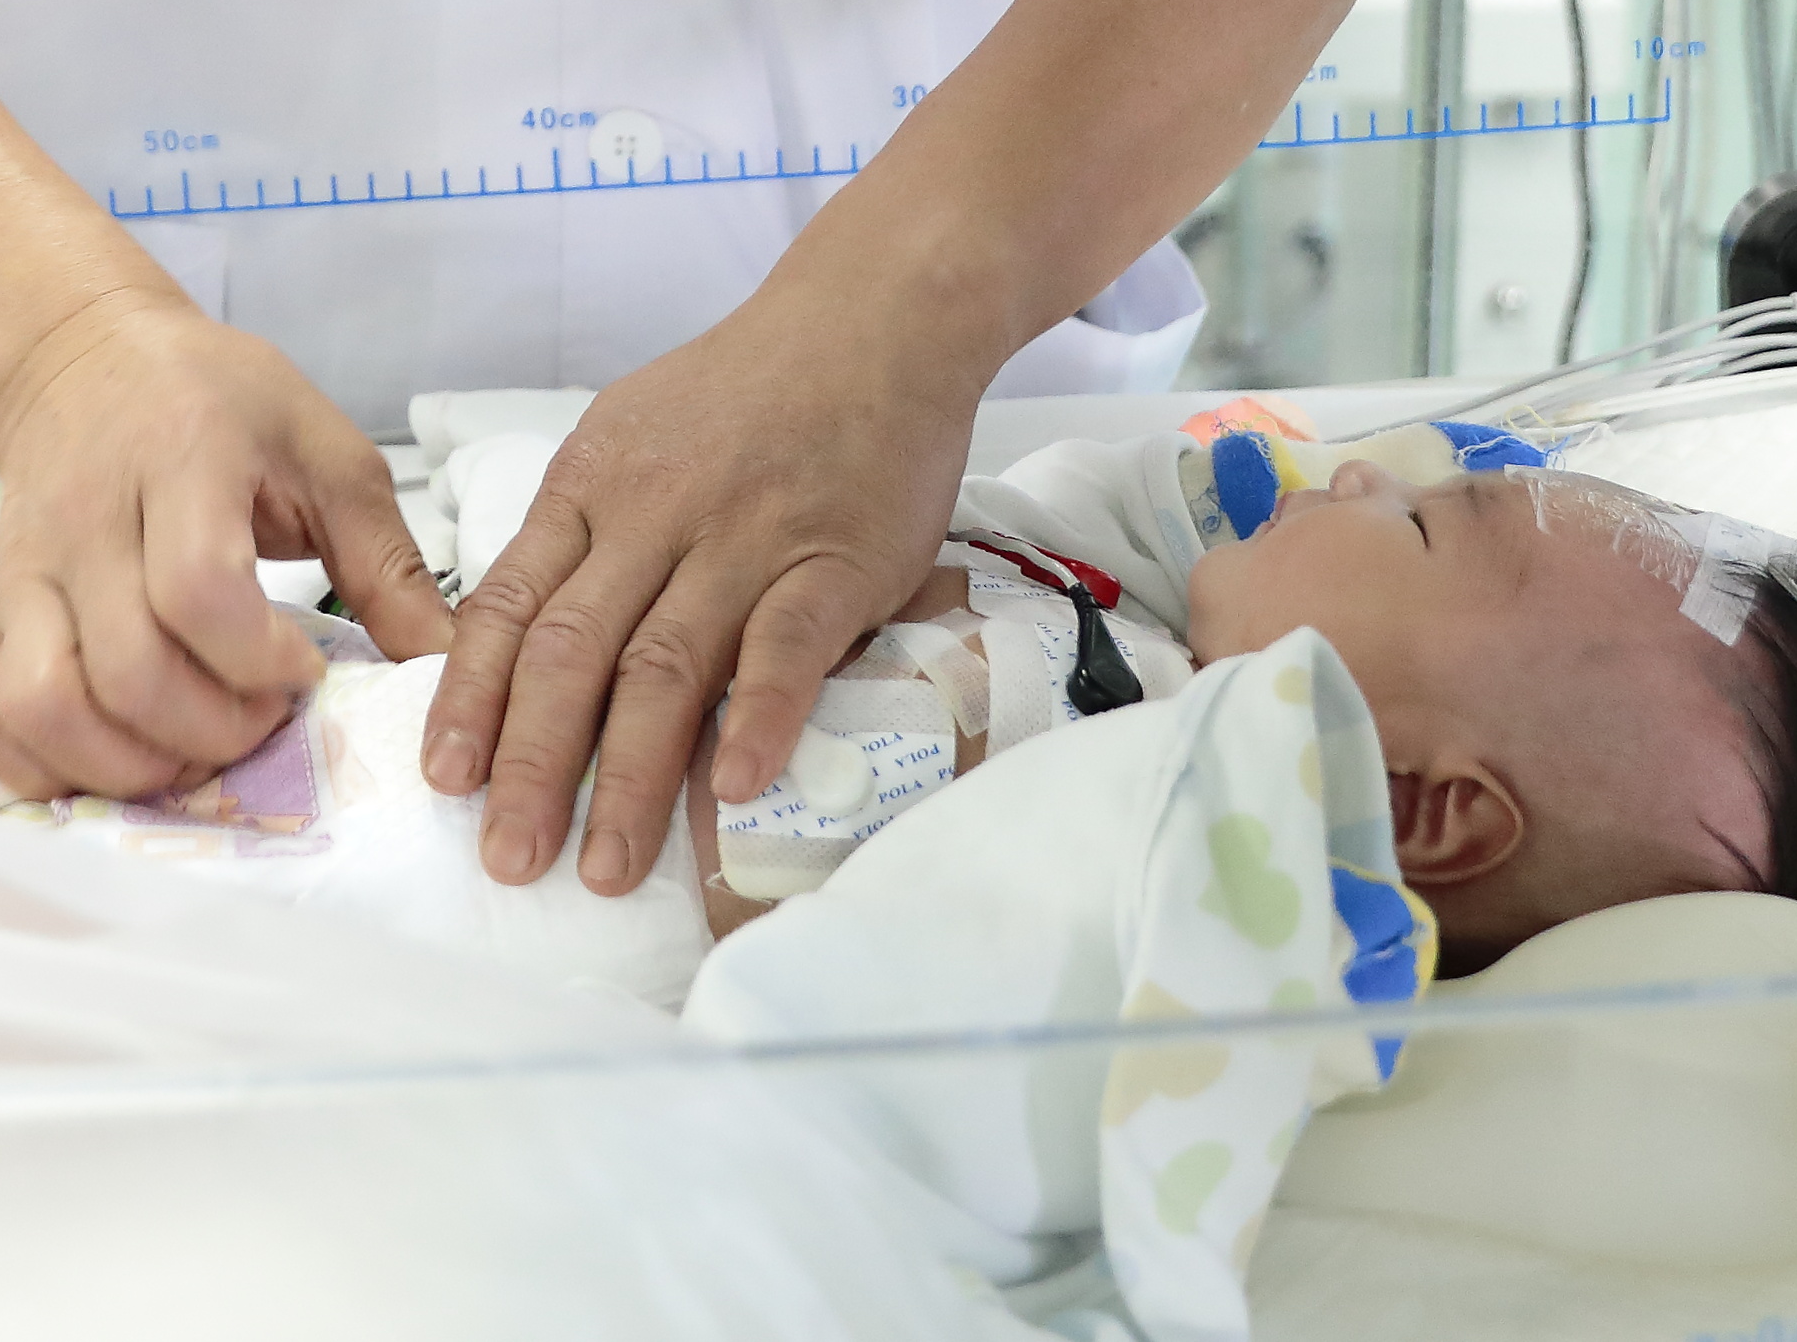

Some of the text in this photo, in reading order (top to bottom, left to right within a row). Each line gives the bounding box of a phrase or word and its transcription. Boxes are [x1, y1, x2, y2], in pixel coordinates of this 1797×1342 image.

[1633, 36, 1707, 61] 10cm
[521, 108, 598, 131] 40cm
[143, 129, 220, 155] 50cm
[894, 743, 941, 769] POLA
[878, 779, 924, 805] POLA
